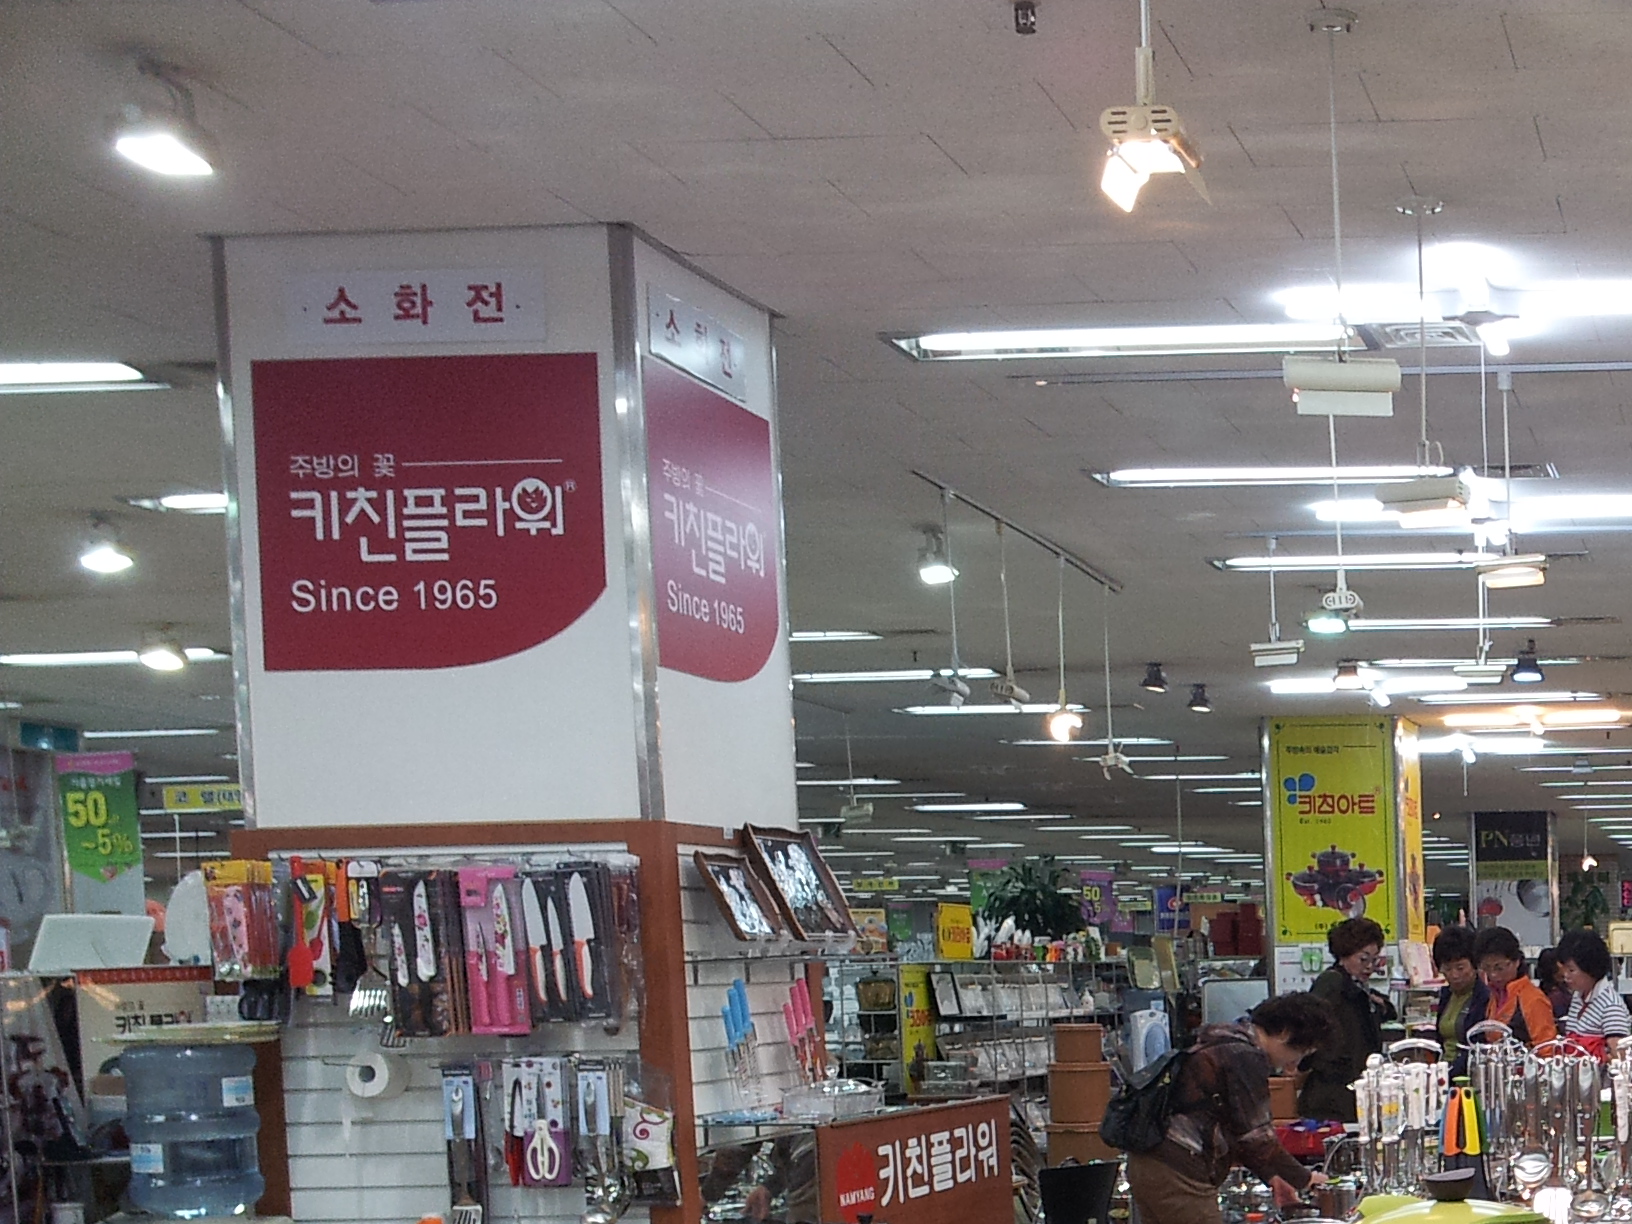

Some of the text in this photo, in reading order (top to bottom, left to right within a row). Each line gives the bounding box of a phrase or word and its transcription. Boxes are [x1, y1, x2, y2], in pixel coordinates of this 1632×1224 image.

[322, 280, 506, 326] 소화전
[289, 452, 396, 479] 주방의 꽃
[662, 457, 691, 492] 주방의
[289, 476, 566, 563] 키친플라워
[663, 491, 766, 584] 키친플라워
[290, 577, 500, 614] Since 1965
[666, 580, 746, 636] Since 1965
[65, 789, 108, 828] 50
[1082, 886, 1101, 901] 50
[877, 1118, 999, 1208] 키친플라워
[839, 1186, 876, 1207] NAMYANG
